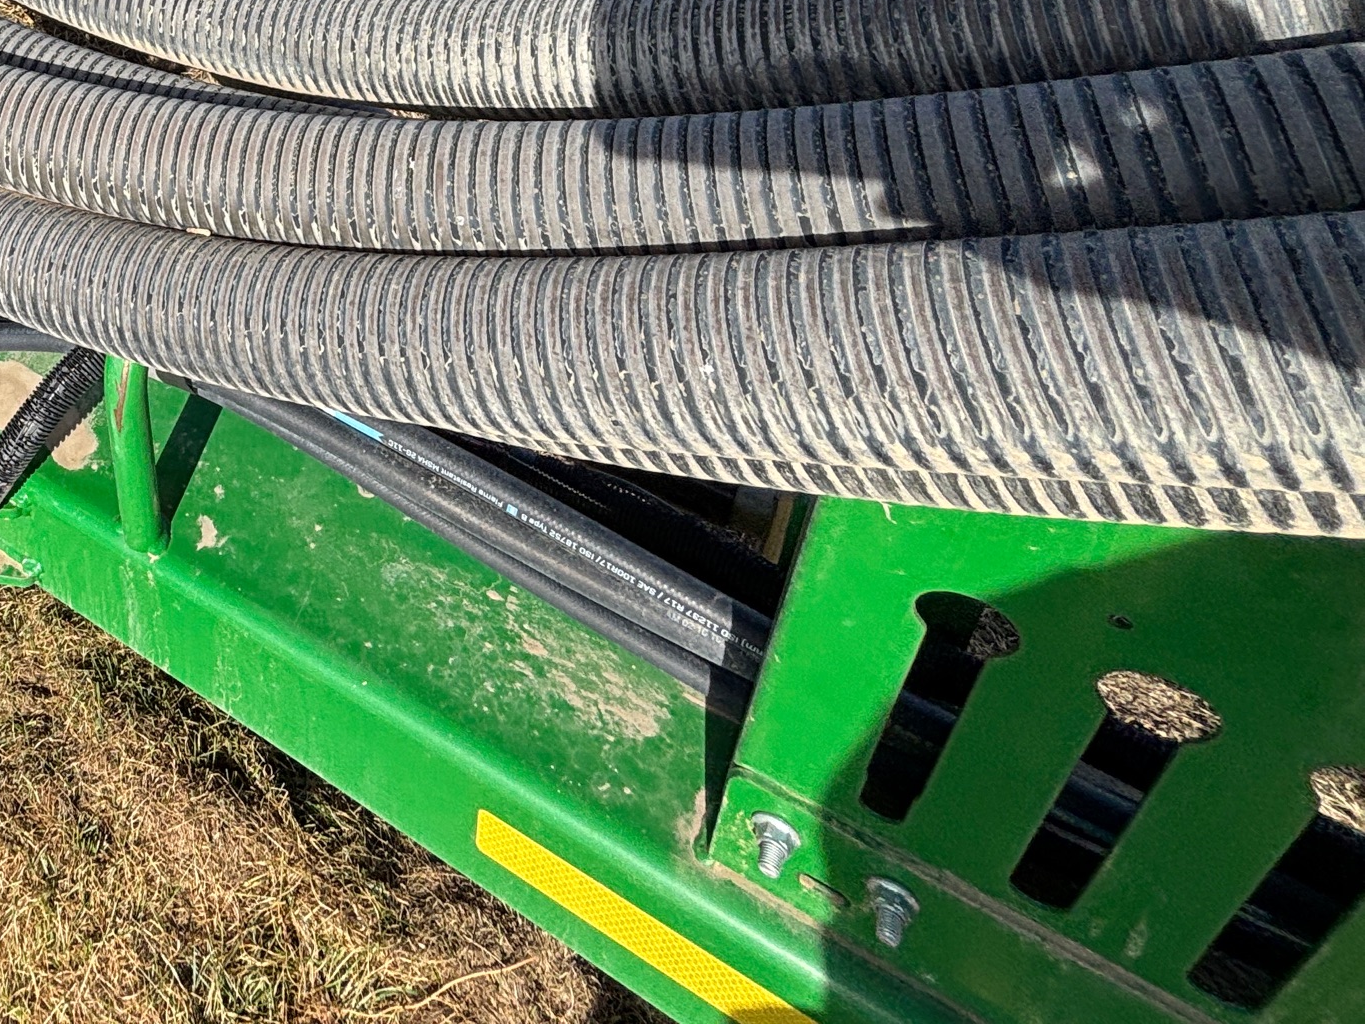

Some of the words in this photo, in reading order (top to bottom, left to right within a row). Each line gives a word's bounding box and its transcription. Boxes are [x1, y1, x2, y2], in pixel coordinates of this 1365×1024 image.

[417, 455, 440, 472] MSHA
[440, 467, 477, 493] Resistant
[478, 488, 504, 508] Flame
[528, 517, 548, 534] Type
[548, 528, 578, 550] 18752
[578, 546, 595, 560] ISO
[636, 579, 657, 596] SAE
[663, 597, 685, 612] R17
[685, 609, 719, 632] 11237
